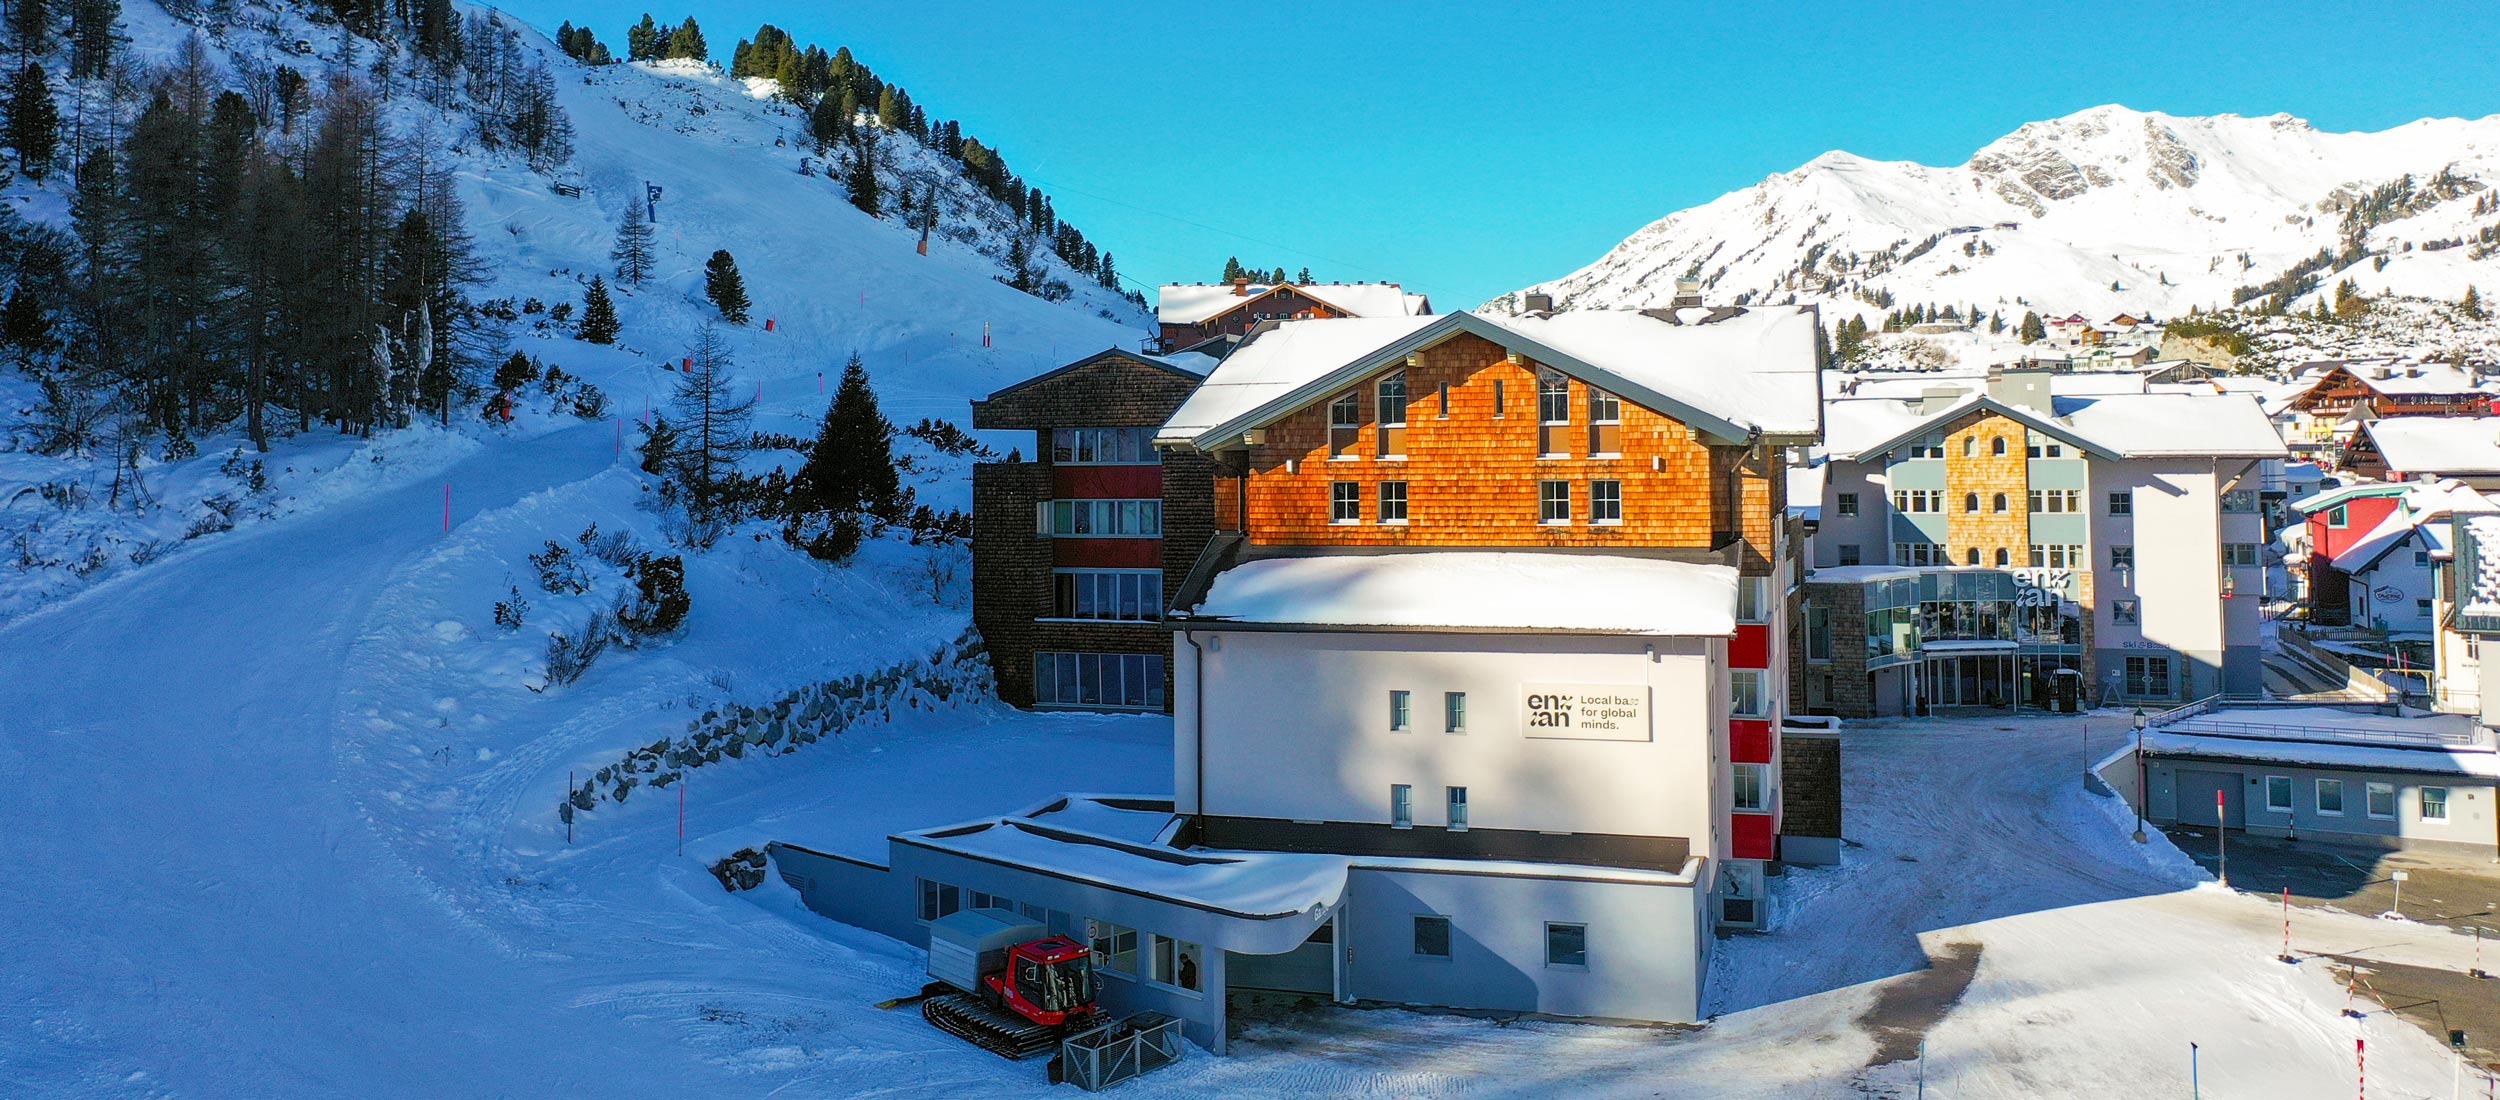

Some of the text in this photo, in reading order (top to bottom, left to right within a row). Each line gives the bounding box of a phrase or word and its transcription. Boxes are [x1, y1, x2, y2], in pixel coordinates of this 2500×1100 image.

[2123, 641, 2136, 649] Ski
[1581, 696, 1611, 705] Local
[1581, 707, 1636, 719] for global
[1581, 720, 1619, 730] minds.
